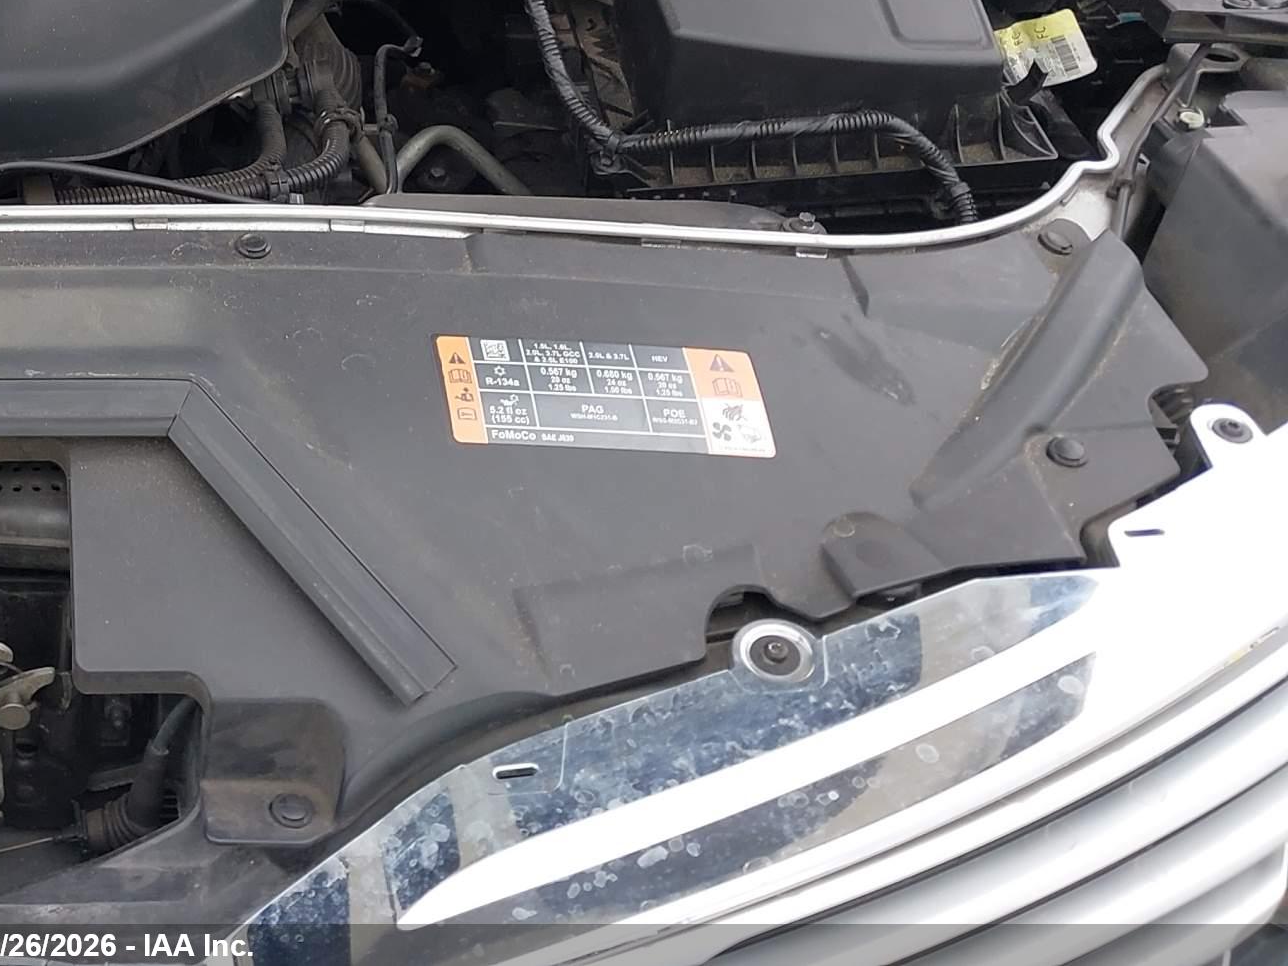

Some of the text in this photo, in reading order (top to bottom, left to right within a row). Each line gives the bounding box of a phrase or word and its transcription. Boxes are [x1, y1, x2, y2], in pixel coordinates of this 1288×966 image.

[565, 368, 578, 378] kg
[621, 370, 633, 381] kg
[486, 377, 520, 386] R-134a
[490, 406, 504, 414] 5.2
[582, 404, 604, 414] PAG
[663, 408, 686, 418] POE
[514, 416, 530, 425] cc)
[491, 430, 536, 440] FoMoCo
